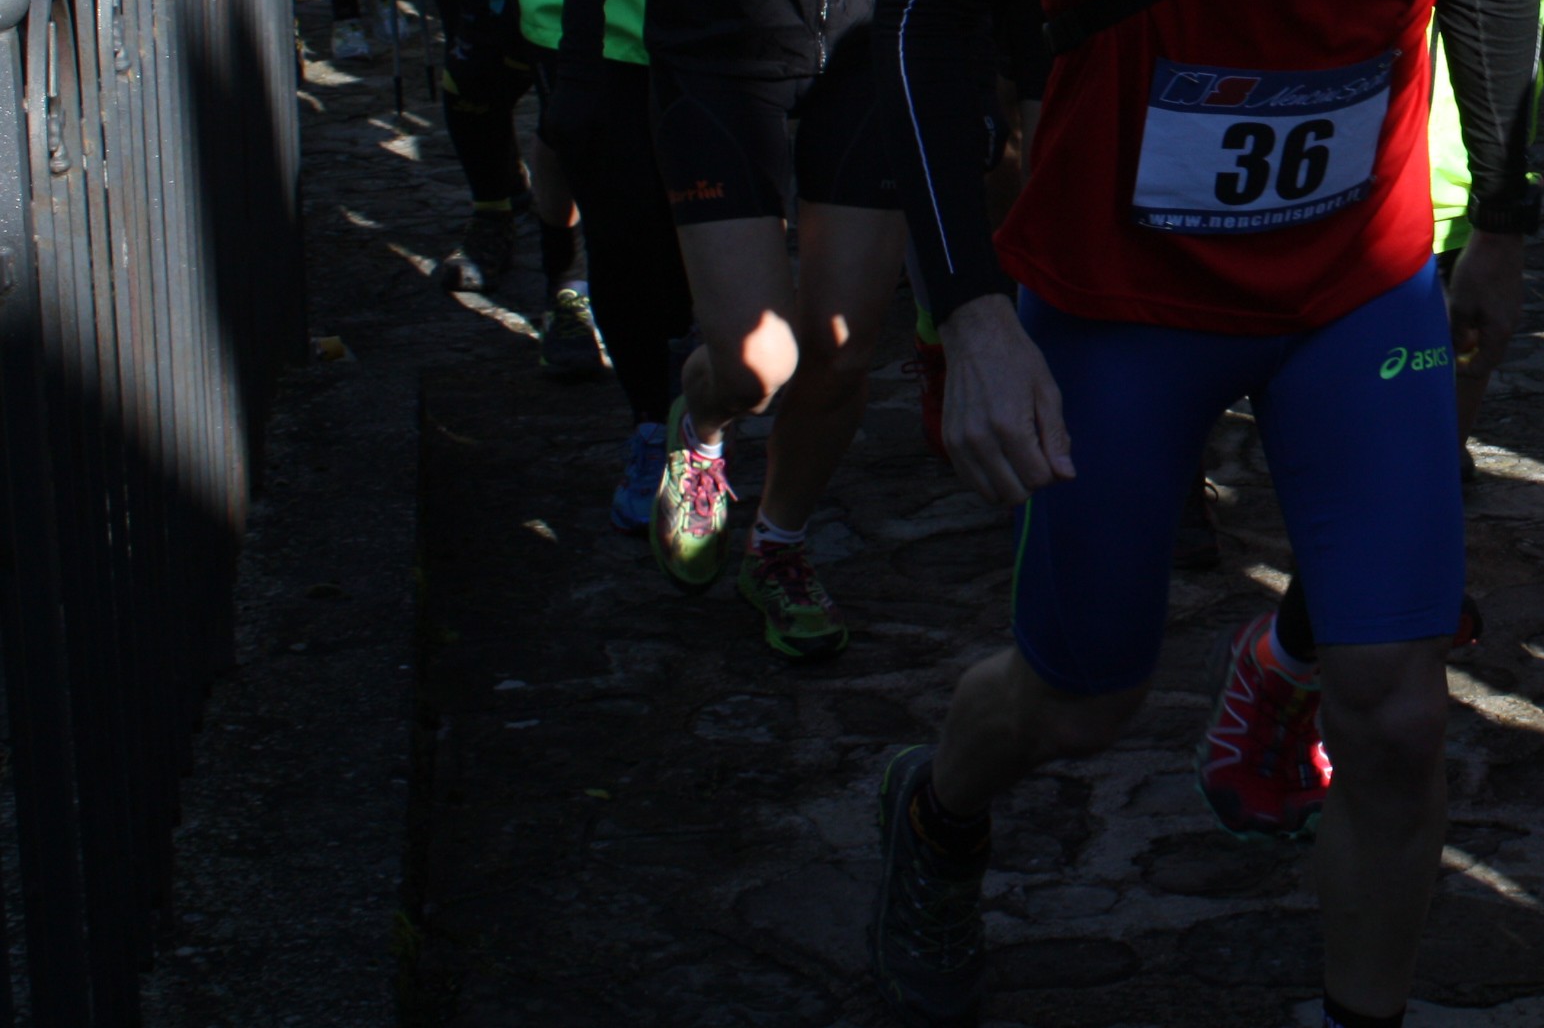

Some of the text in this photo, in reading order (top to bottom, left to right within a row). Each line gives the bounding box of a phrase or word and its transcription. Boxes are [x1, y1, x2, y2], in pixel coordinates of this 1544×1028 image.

[1214, 119, 1335, 206] 36
[1149, 184, 1362, 230] www.nencinisport.it
[1410, 345, 1449, 372] asics
